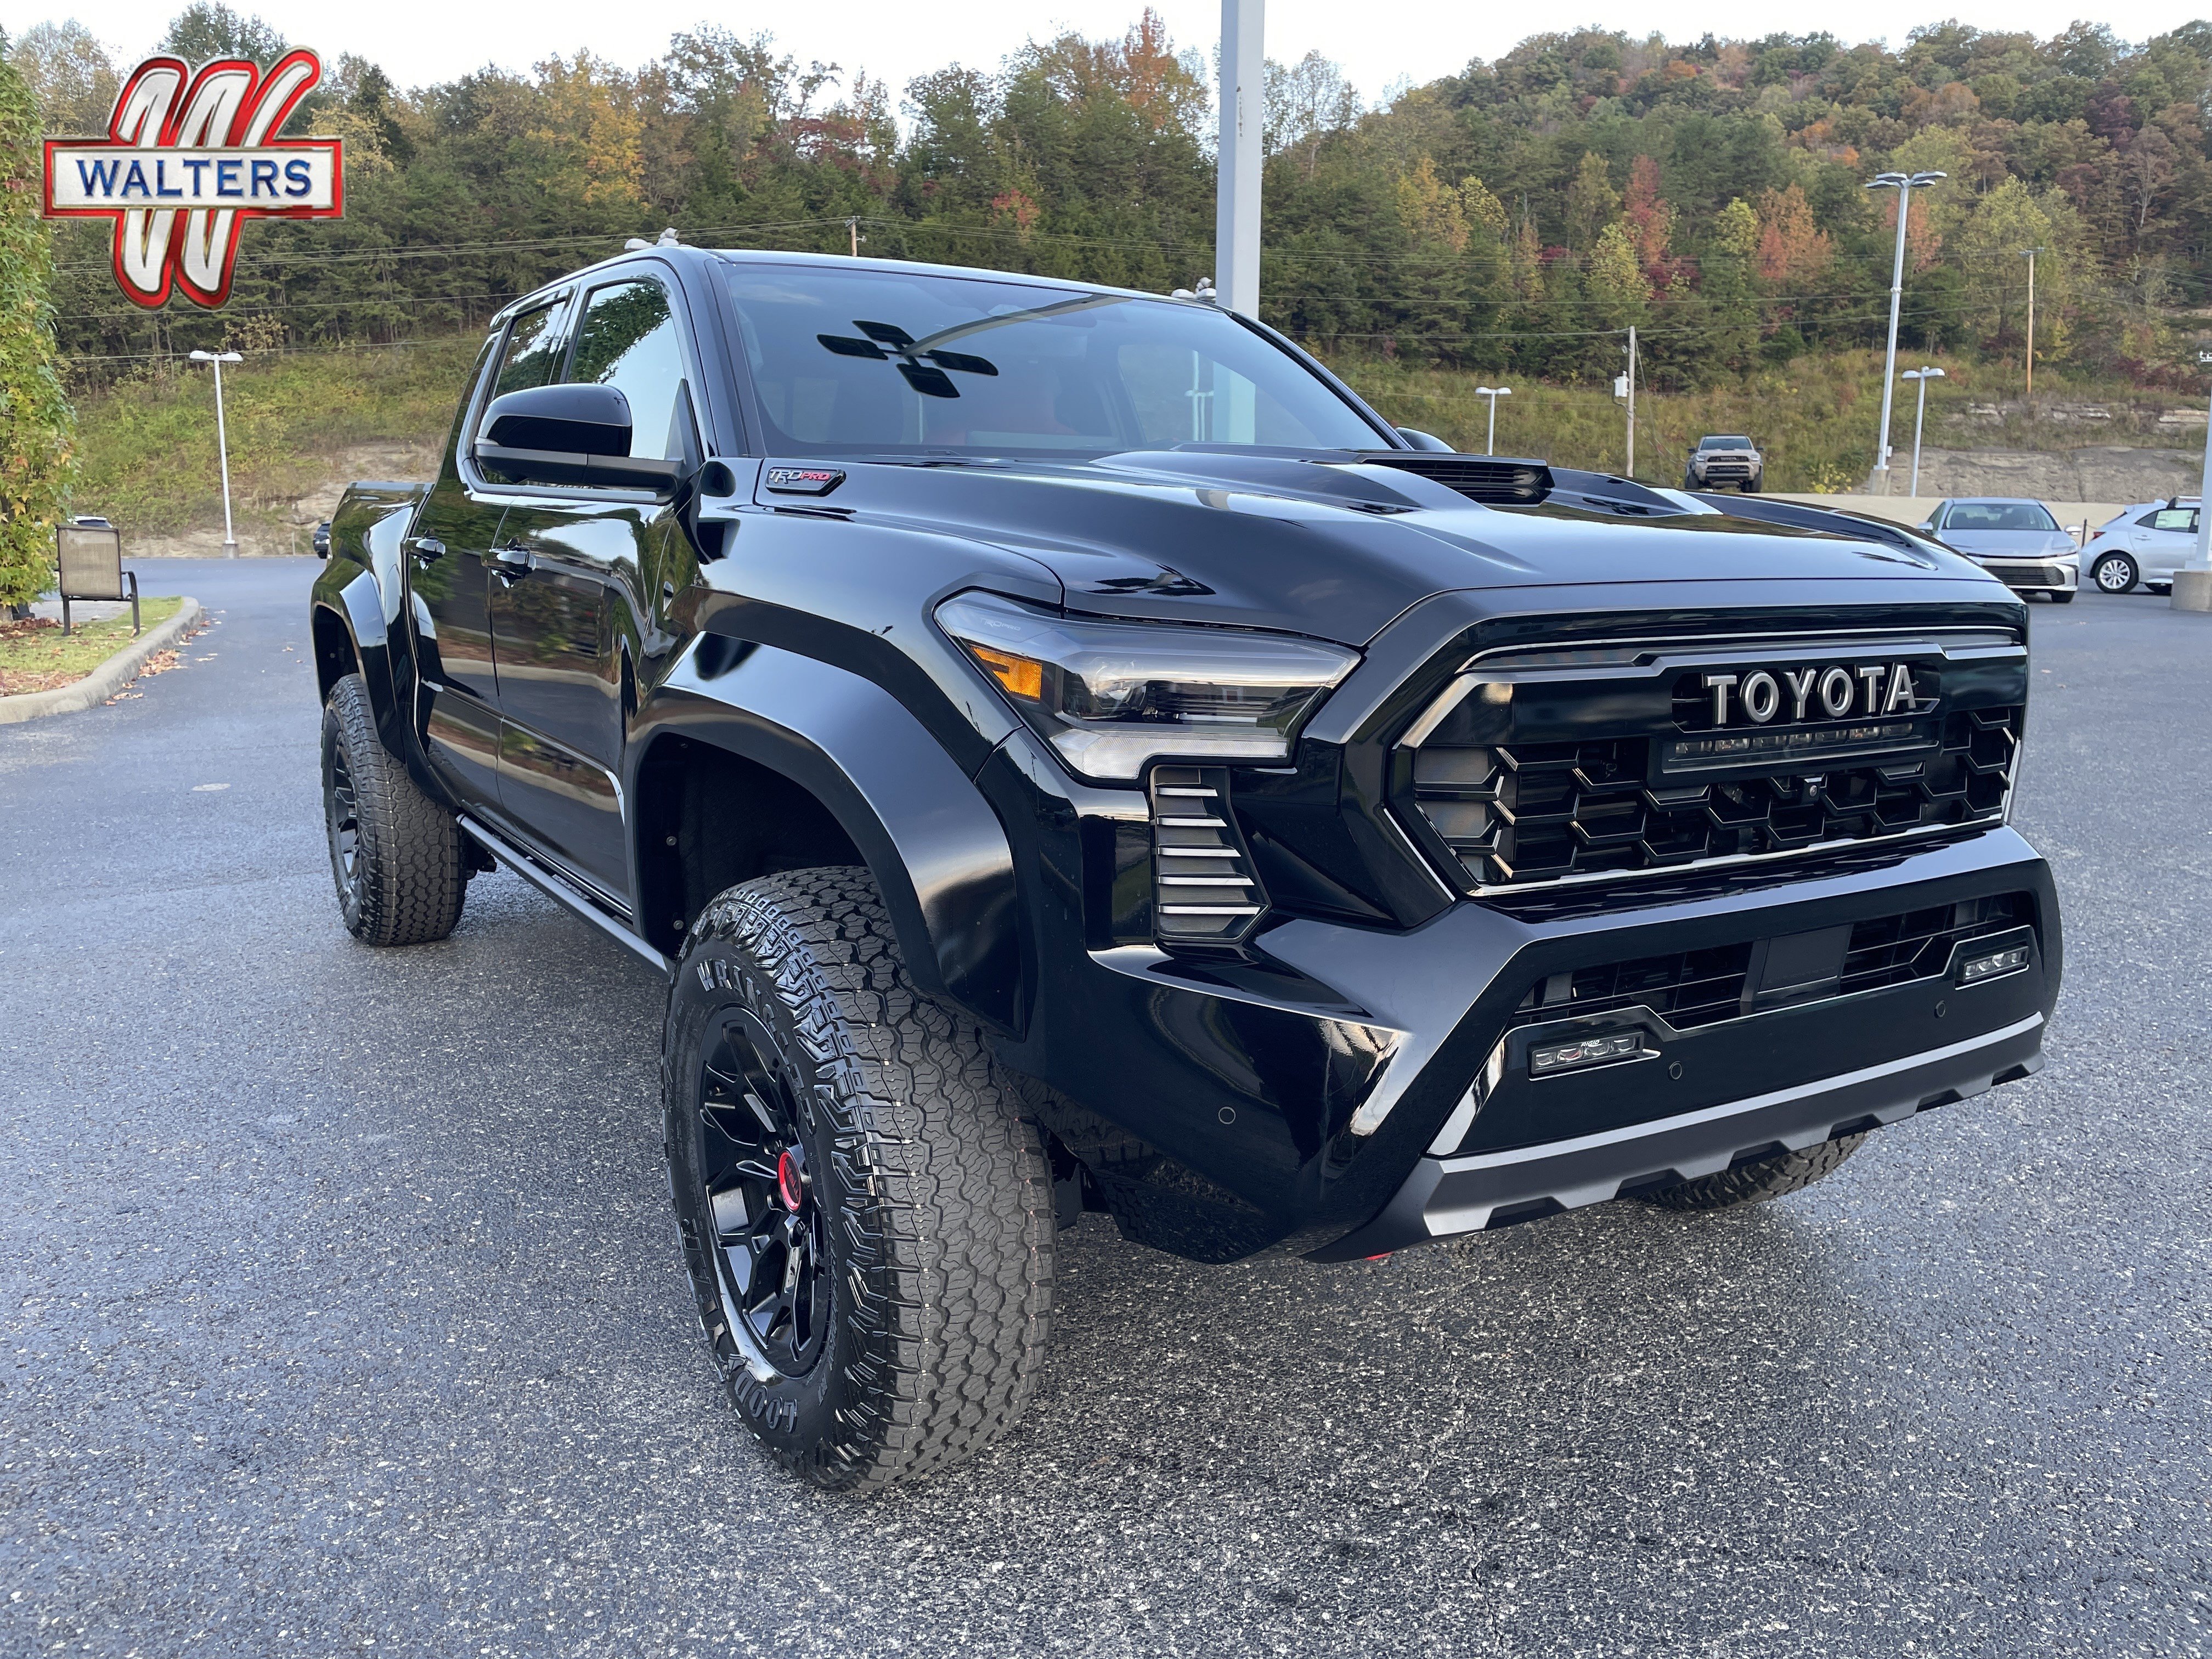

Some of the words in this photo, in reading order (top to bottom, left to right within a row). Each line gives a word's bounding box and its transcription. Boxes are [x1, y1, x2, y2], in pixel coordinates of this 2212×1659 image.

[770, 470, 803, 484] TRD
[800, 472, 831, 481] PRO
[1703, 663, 1916, 726] TOYOTA
